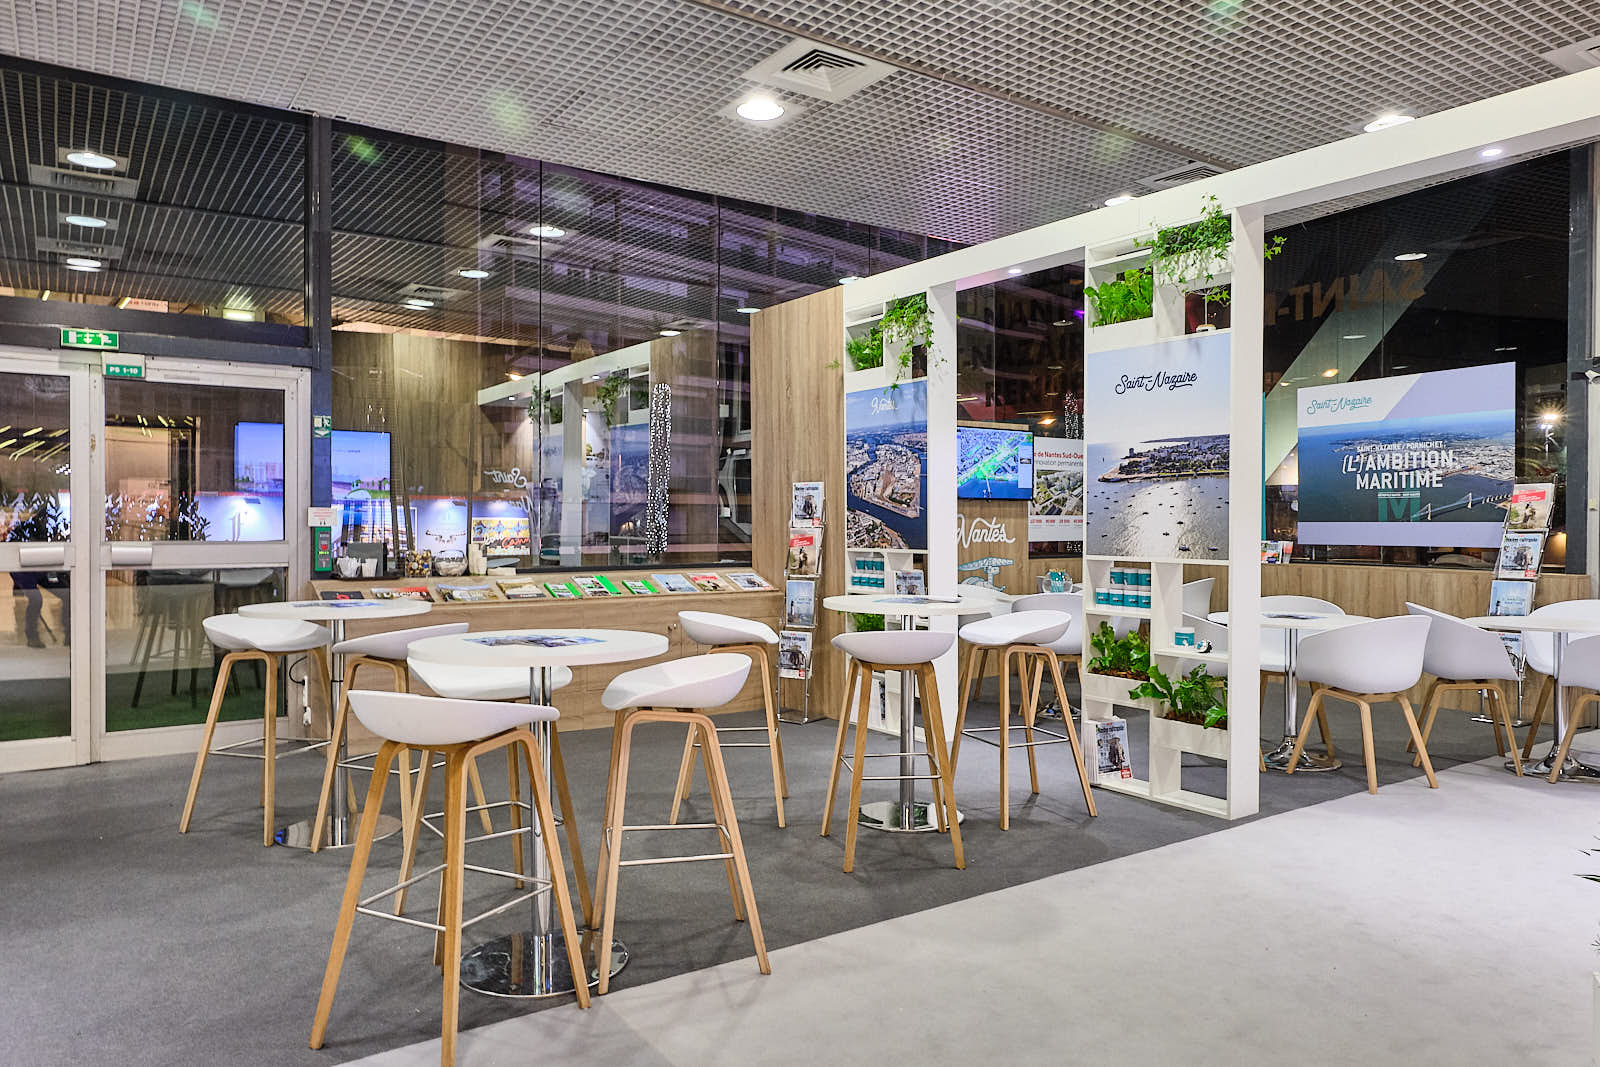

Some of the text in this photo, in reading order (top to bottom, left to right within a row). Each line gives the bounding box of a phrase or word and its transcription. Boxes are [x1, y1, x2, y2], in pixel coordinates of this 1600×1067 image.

[1115, 371, 1198, 395] Saint-Nazaire
[1307, 395, 1373, 415] Saint-Nazaire
[1356, 470, 1444, 490] MARITIME
[957, 513, 1017, 549] Nantes
